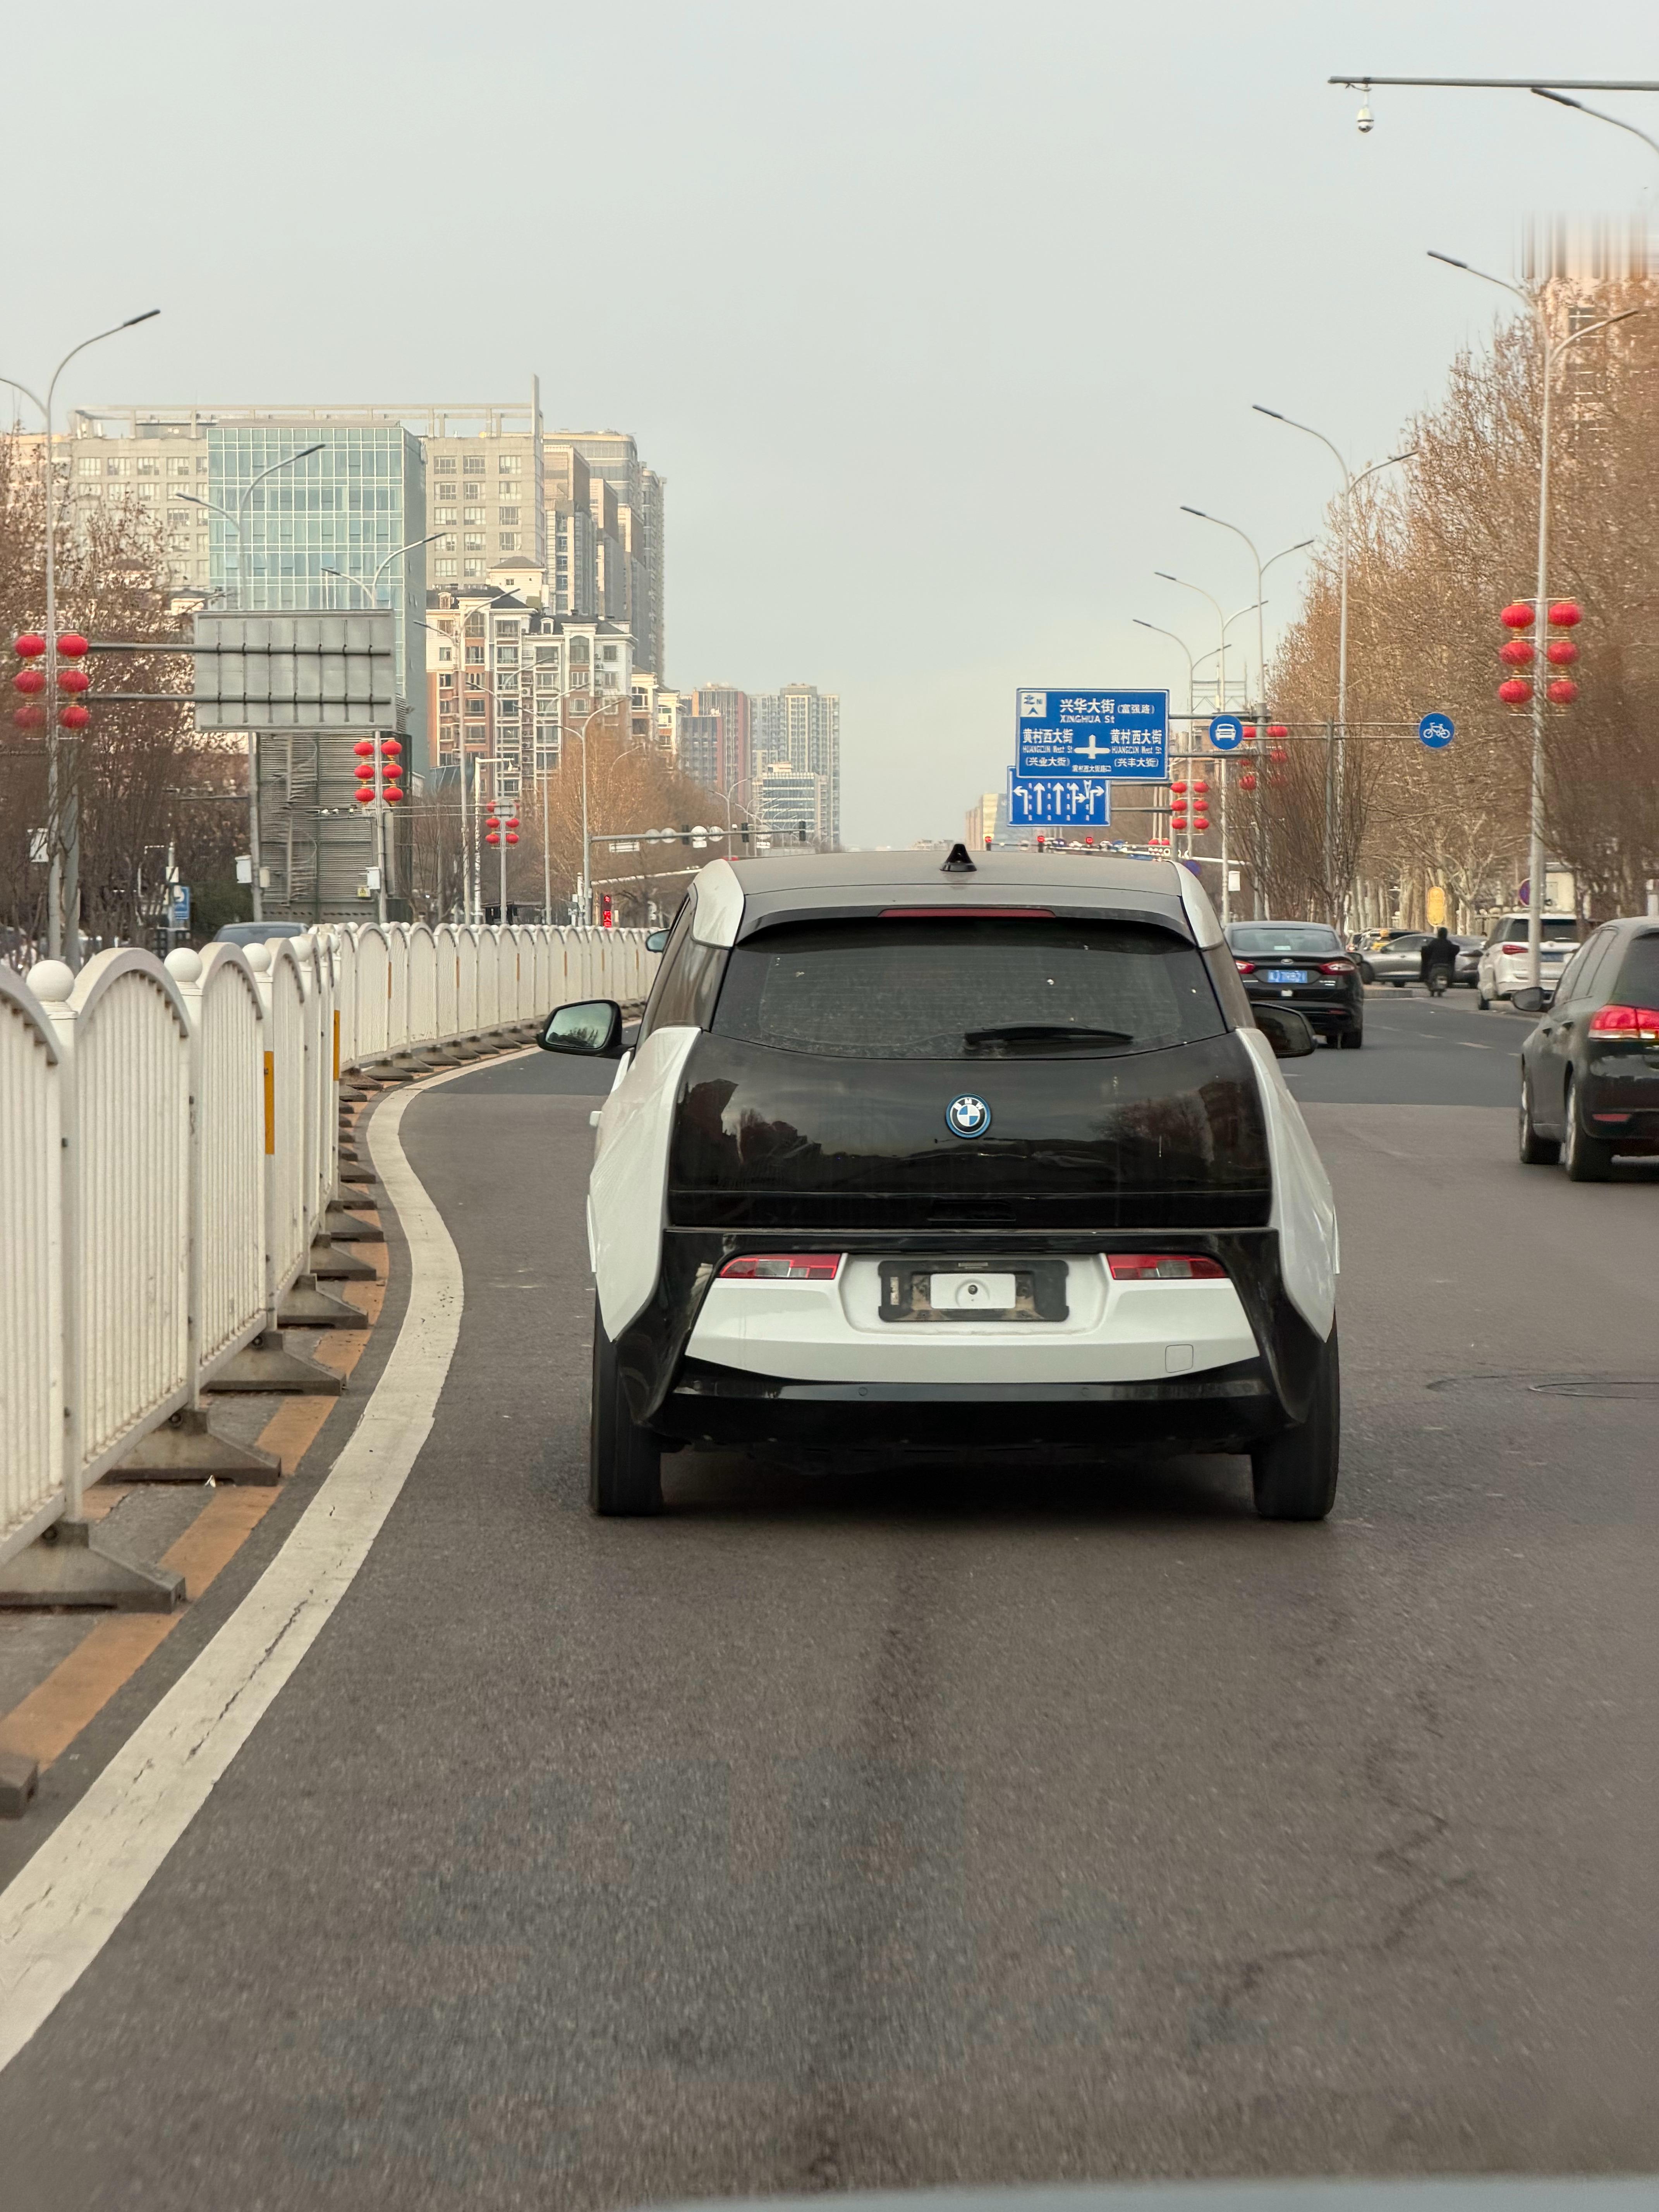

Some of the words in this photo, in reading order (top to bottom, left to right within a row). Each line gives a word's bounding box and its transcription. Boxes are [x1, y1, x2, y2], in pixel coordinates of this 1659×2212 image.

[1024, 695, 1035, 704] 北
[1060, 698, 1115, 713] 兴华大街
[1060, 714, 1101, 723] XINGHUA
[1104, 715, 1115, 723] St
[1023, 728, 1073, 744] 黄村西大街
[1110, 728, 1162, 744] 黄村西大街
[953, 1098, 985, 1110] BMW
